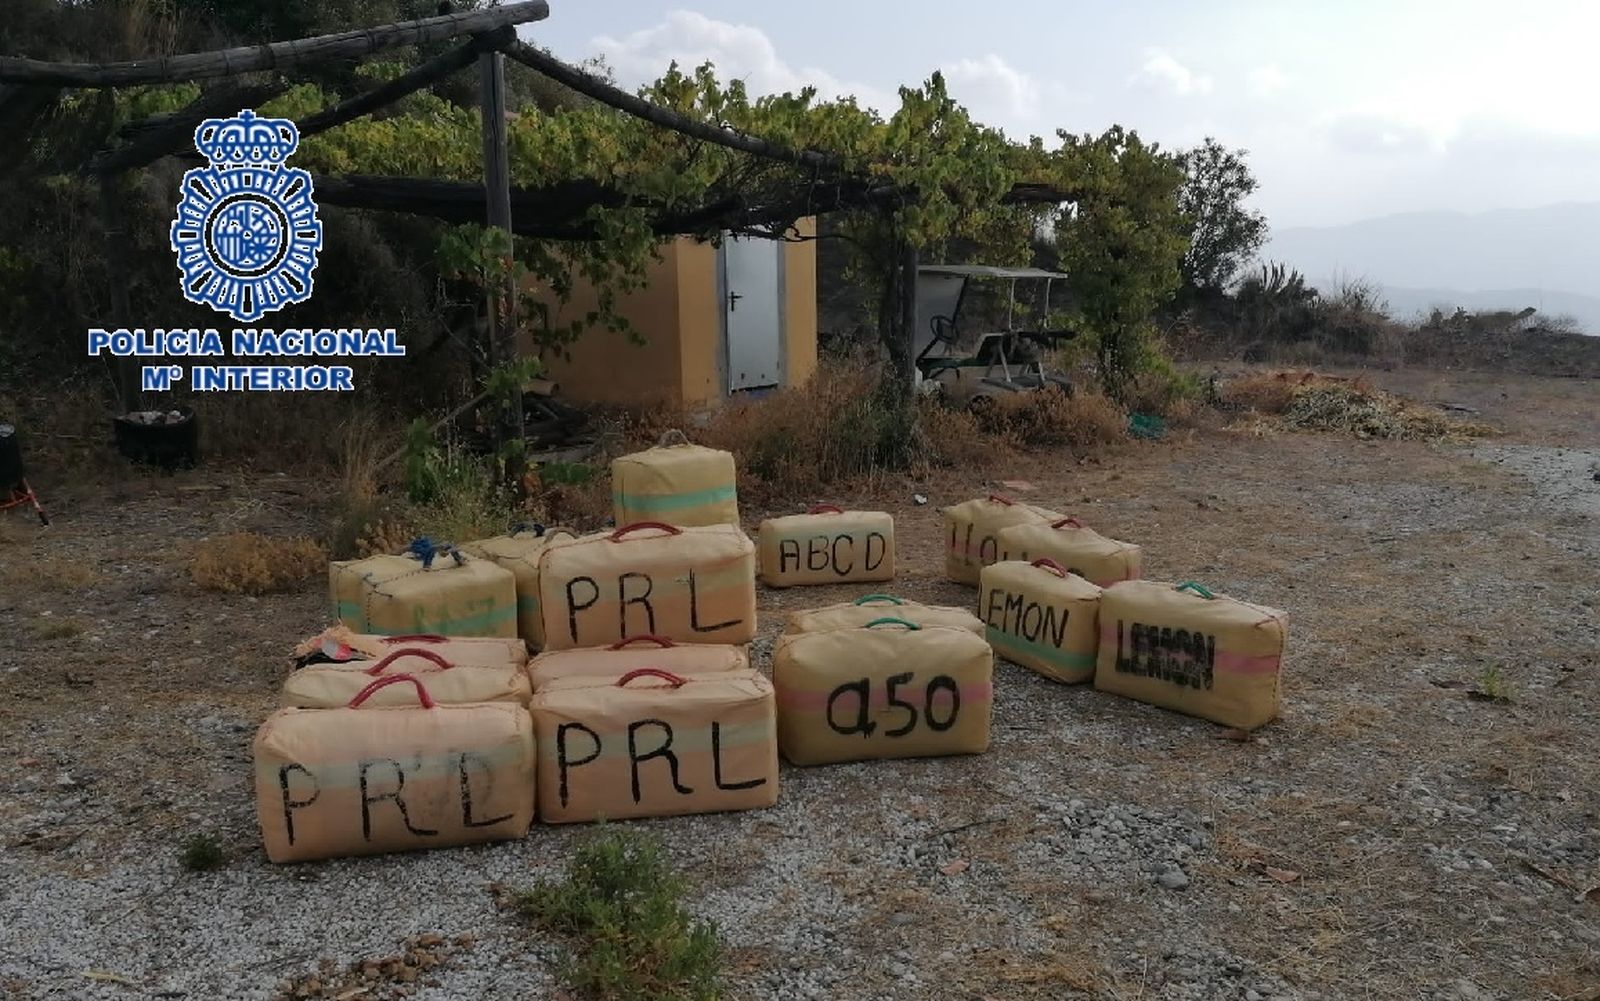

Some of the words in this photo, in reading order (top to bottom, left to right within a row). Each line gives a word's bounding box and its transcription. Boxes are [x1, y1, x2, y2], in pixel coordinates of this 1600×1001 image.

[779, 532, 886, 576] ABCD
[567, 567, 742, 644] PRL
[556, 718, 767, 808] PRL
